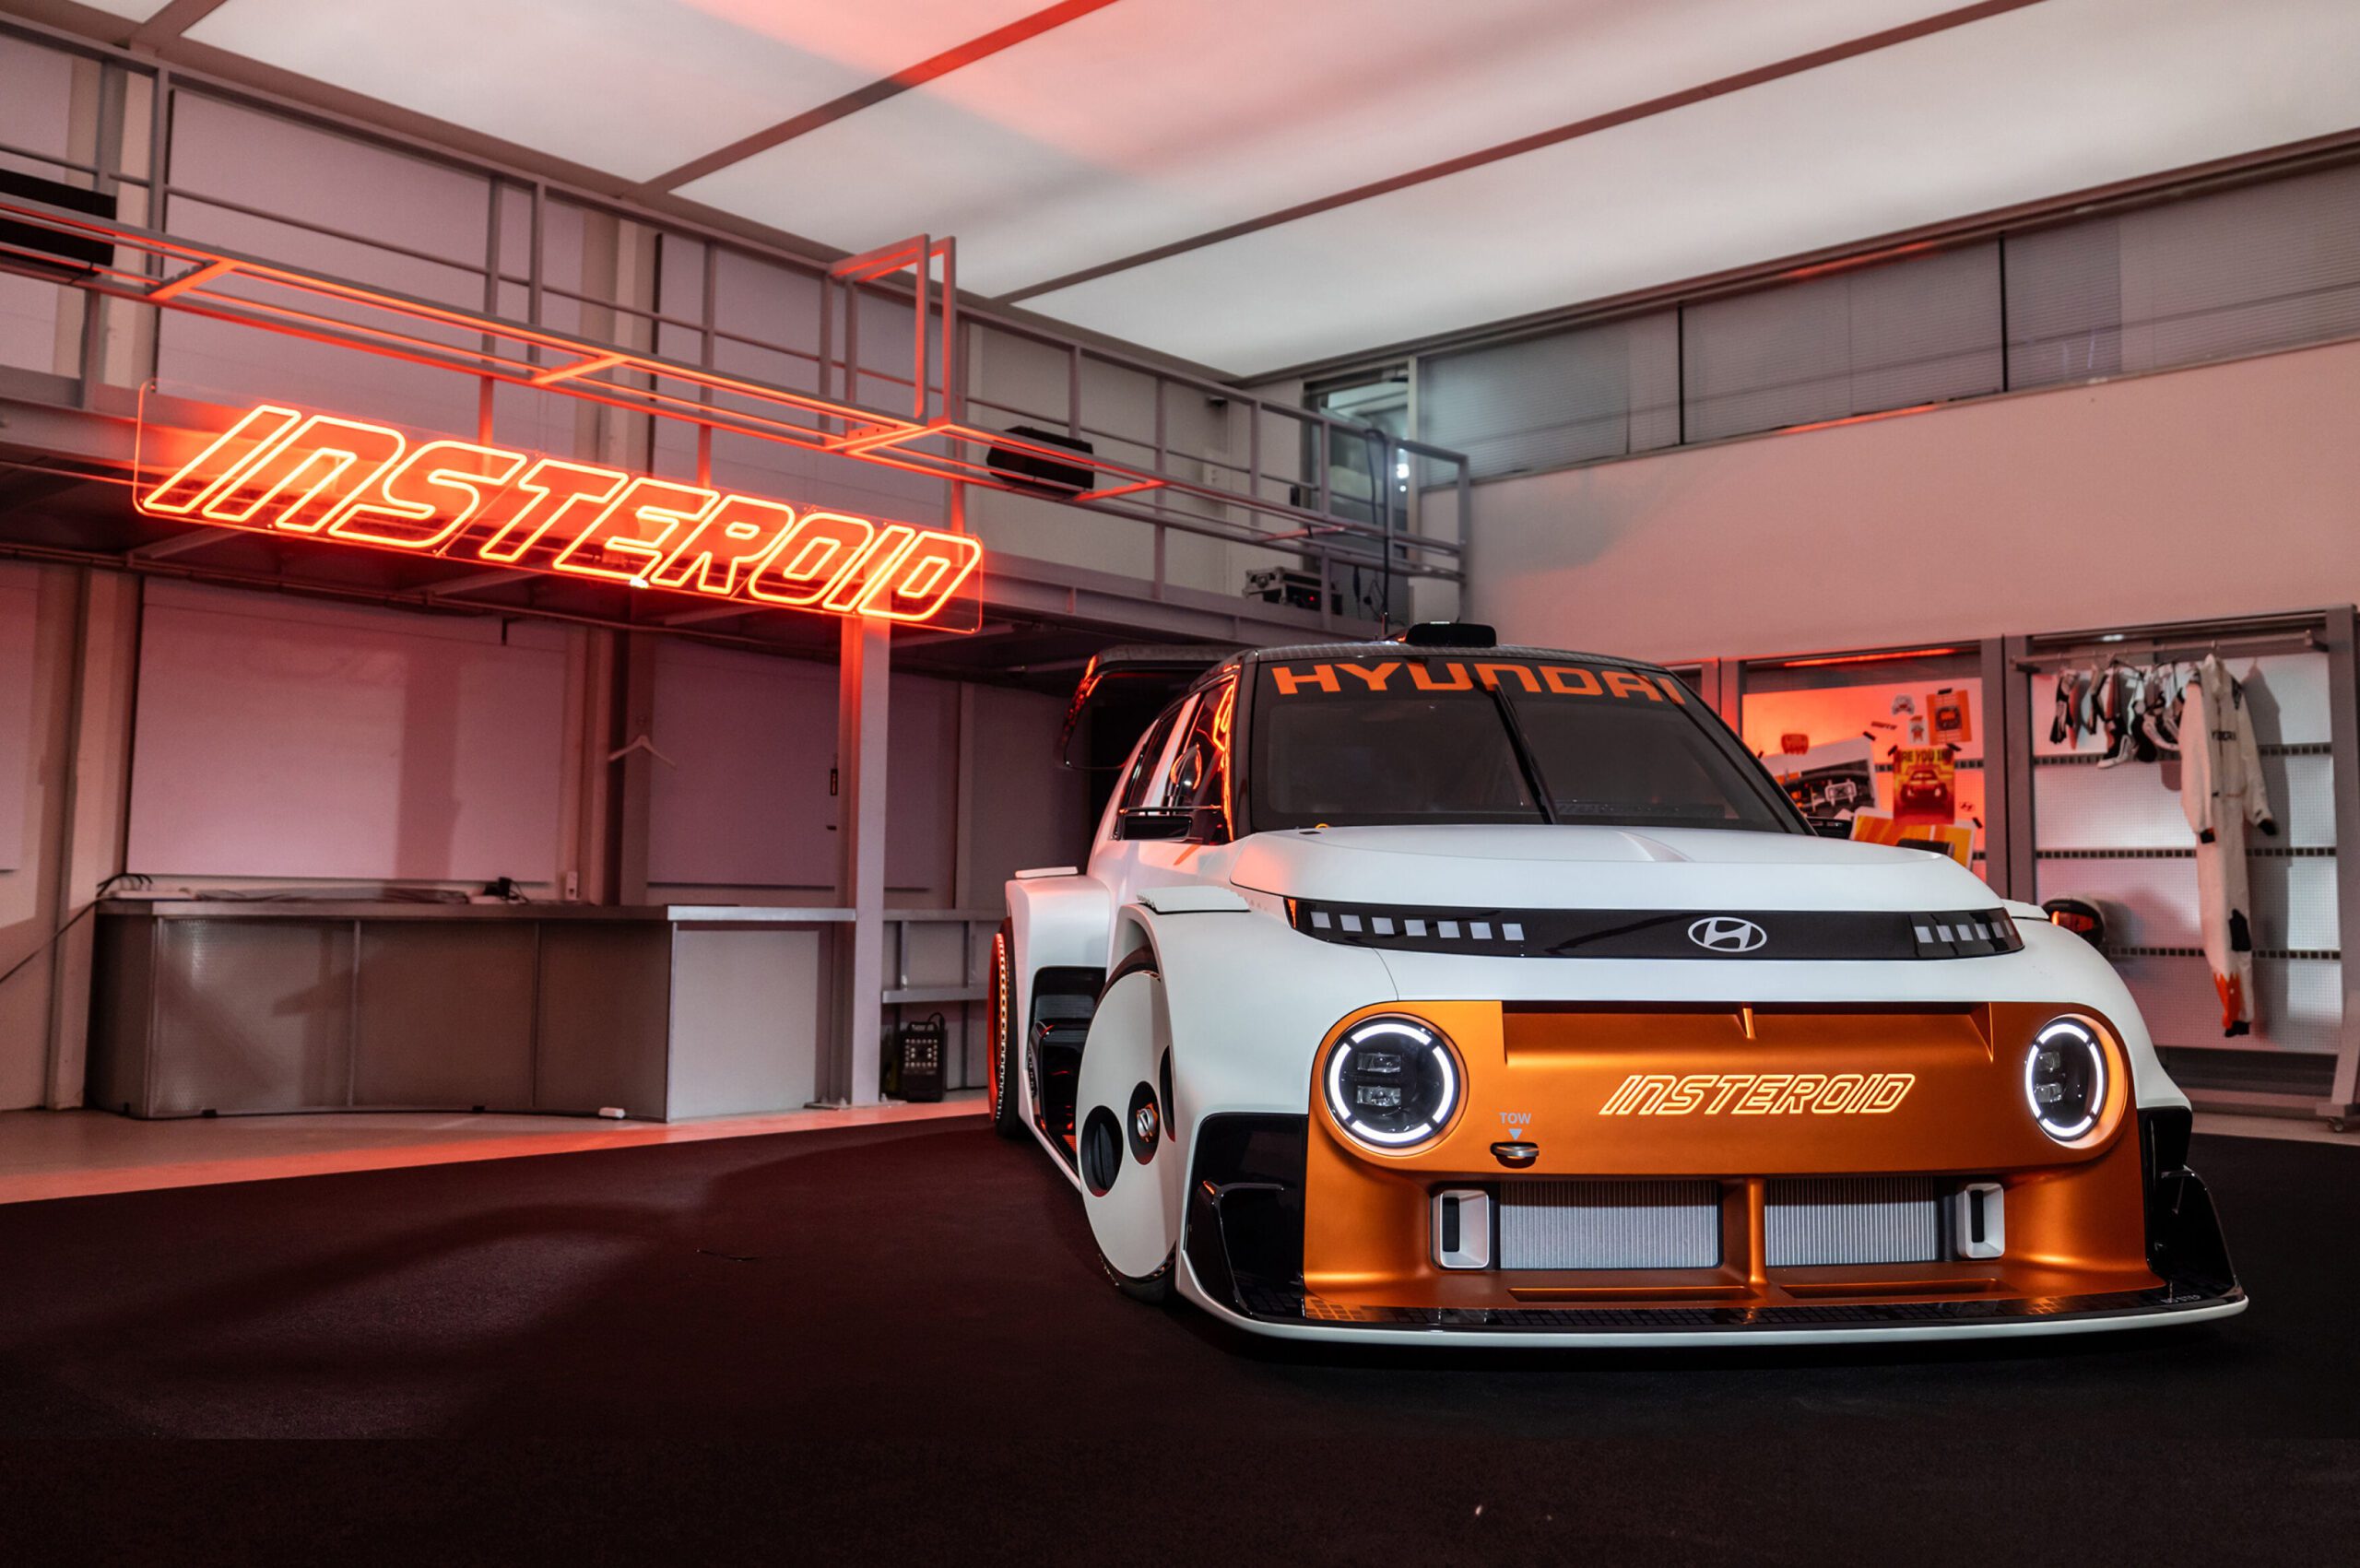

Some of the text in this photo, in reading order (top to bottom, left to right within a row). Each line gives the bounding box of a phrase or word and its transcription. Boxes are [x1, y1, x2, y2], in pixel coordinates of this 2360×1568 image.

[142, 404, 983, 621] INSTEROID
[1271, 662, 1686, 705] HYUNDAI
[1599, 1073, 1916, 1115] INSTEROID
[1499, 1112, 1532, 1124] TOW
